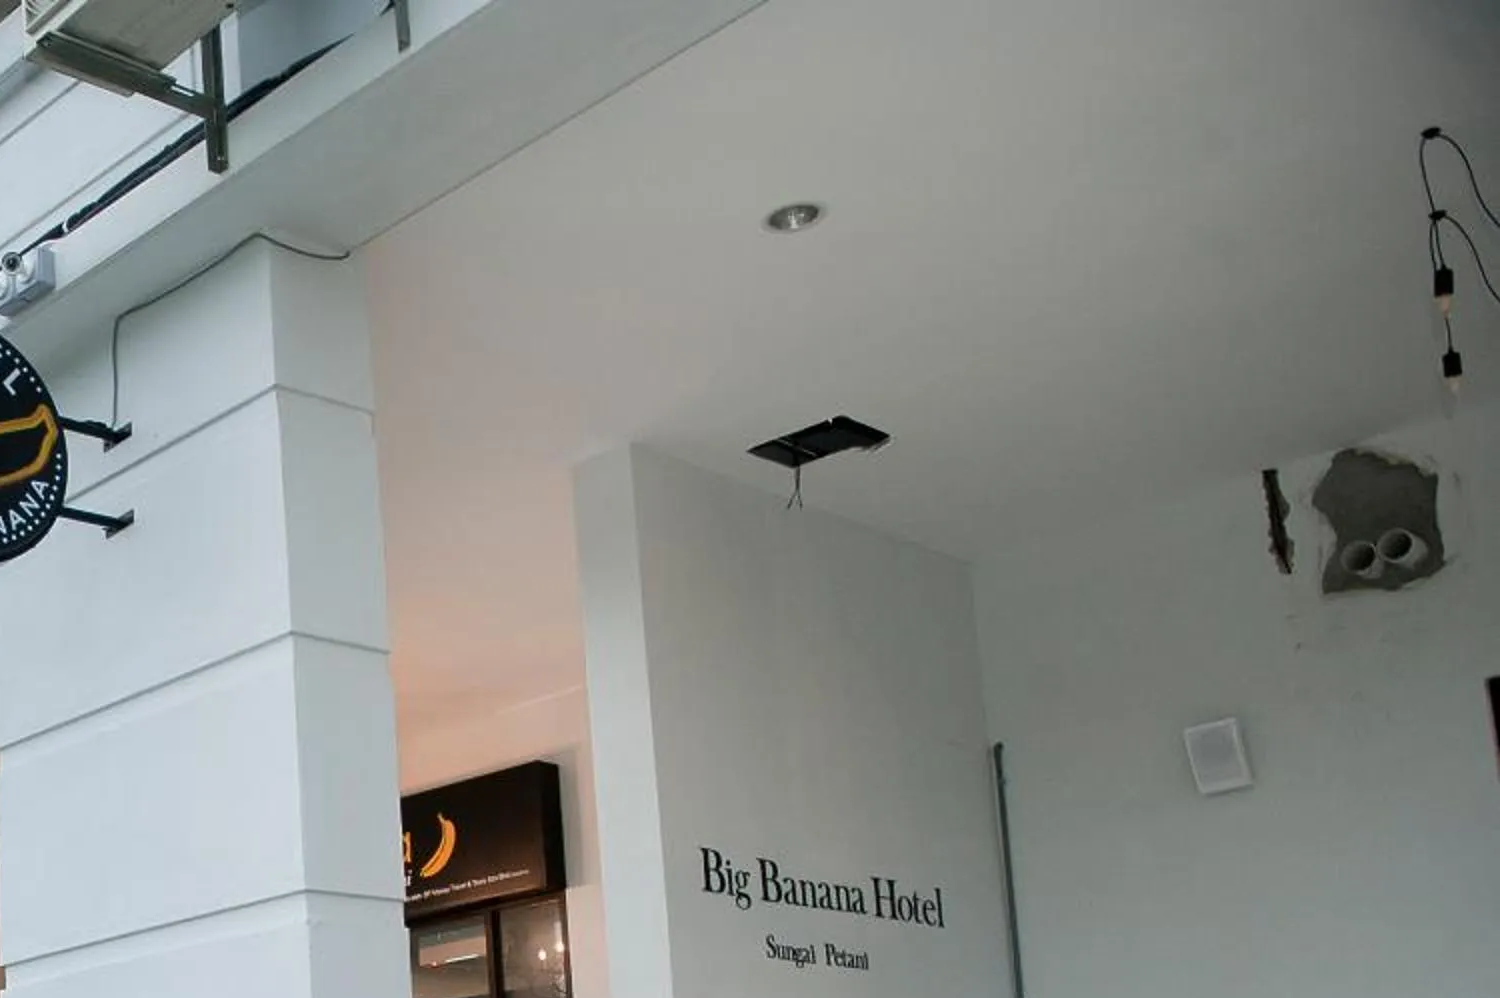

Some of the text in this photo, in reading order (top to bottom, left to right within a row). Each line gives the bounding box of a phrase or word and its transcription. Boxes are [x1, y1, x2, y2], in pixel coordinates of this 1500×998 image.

[700, 847, 945, 929] Big Banana Hotel
[765, 933, 870, 971] Sungai Petani
